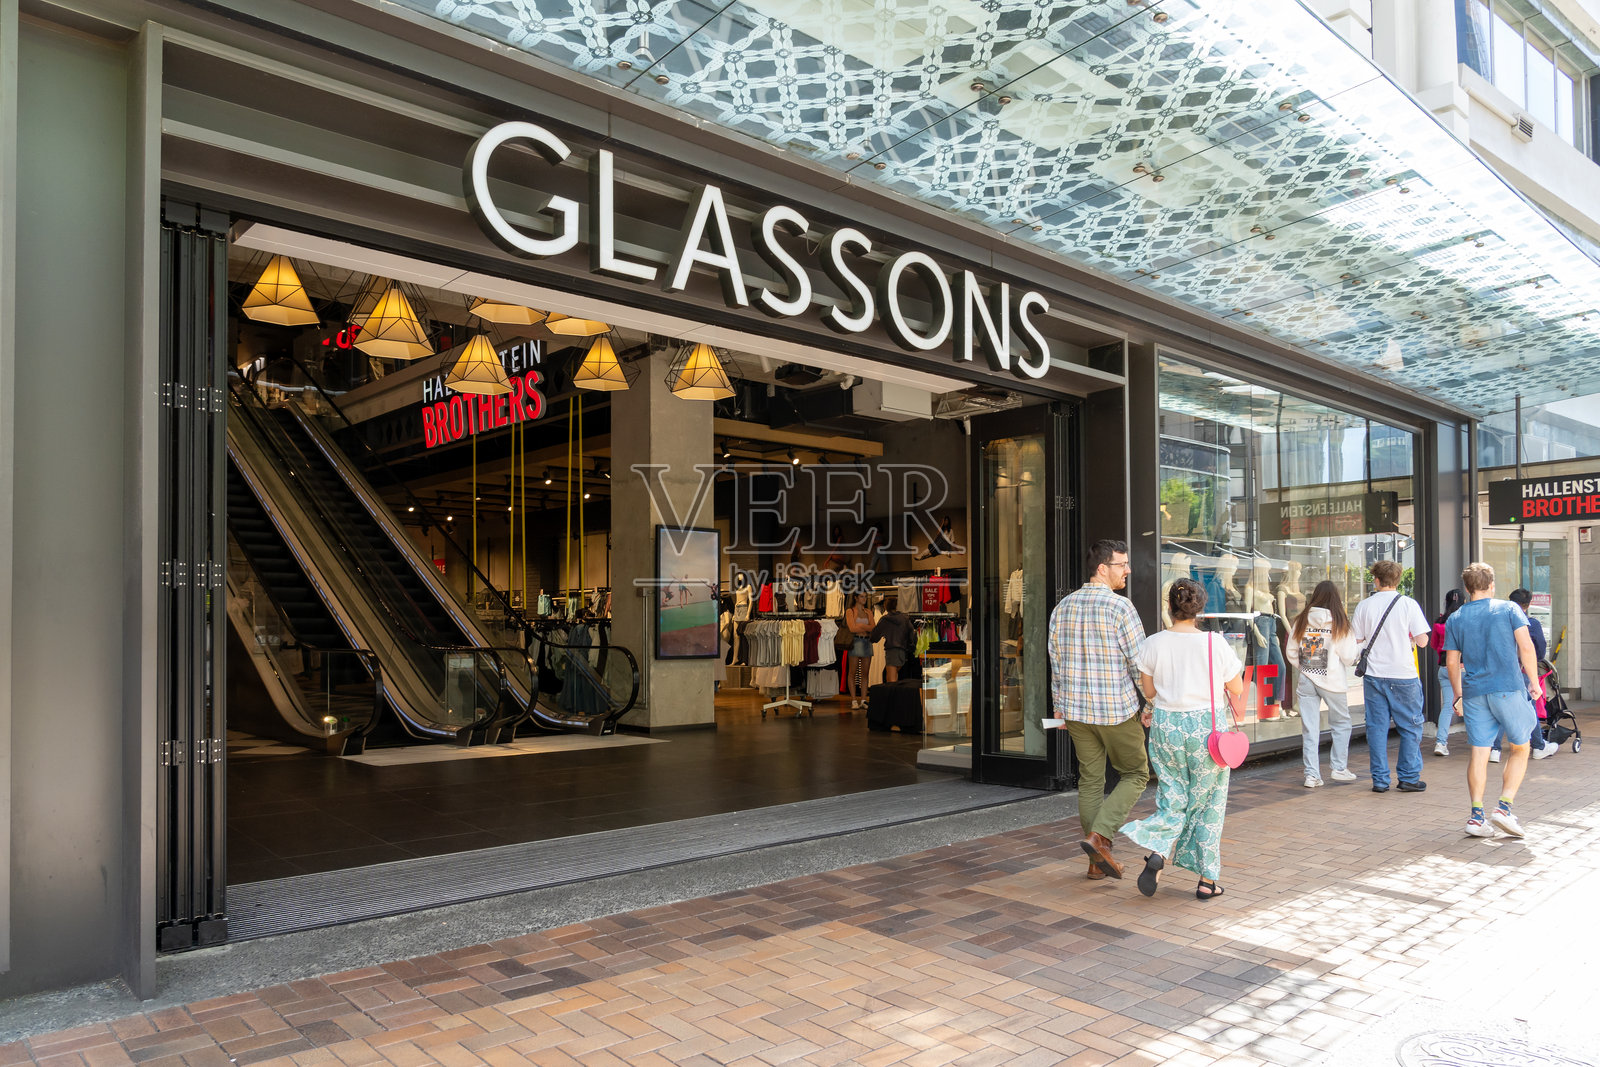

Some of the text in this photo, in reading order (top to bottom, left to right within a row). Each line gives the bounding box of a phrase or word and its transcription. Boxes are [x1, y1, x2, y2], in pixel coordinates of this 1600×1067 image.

[471, 121, 1050, 379] GLASSONS
[423, 339, 541, 403] HALTEIN
[422, 370, 543, 449] BROTHERS
[1522, 478, 1600, 498] HALLENST
[1522, 494, 1600, 518] BROTHE
